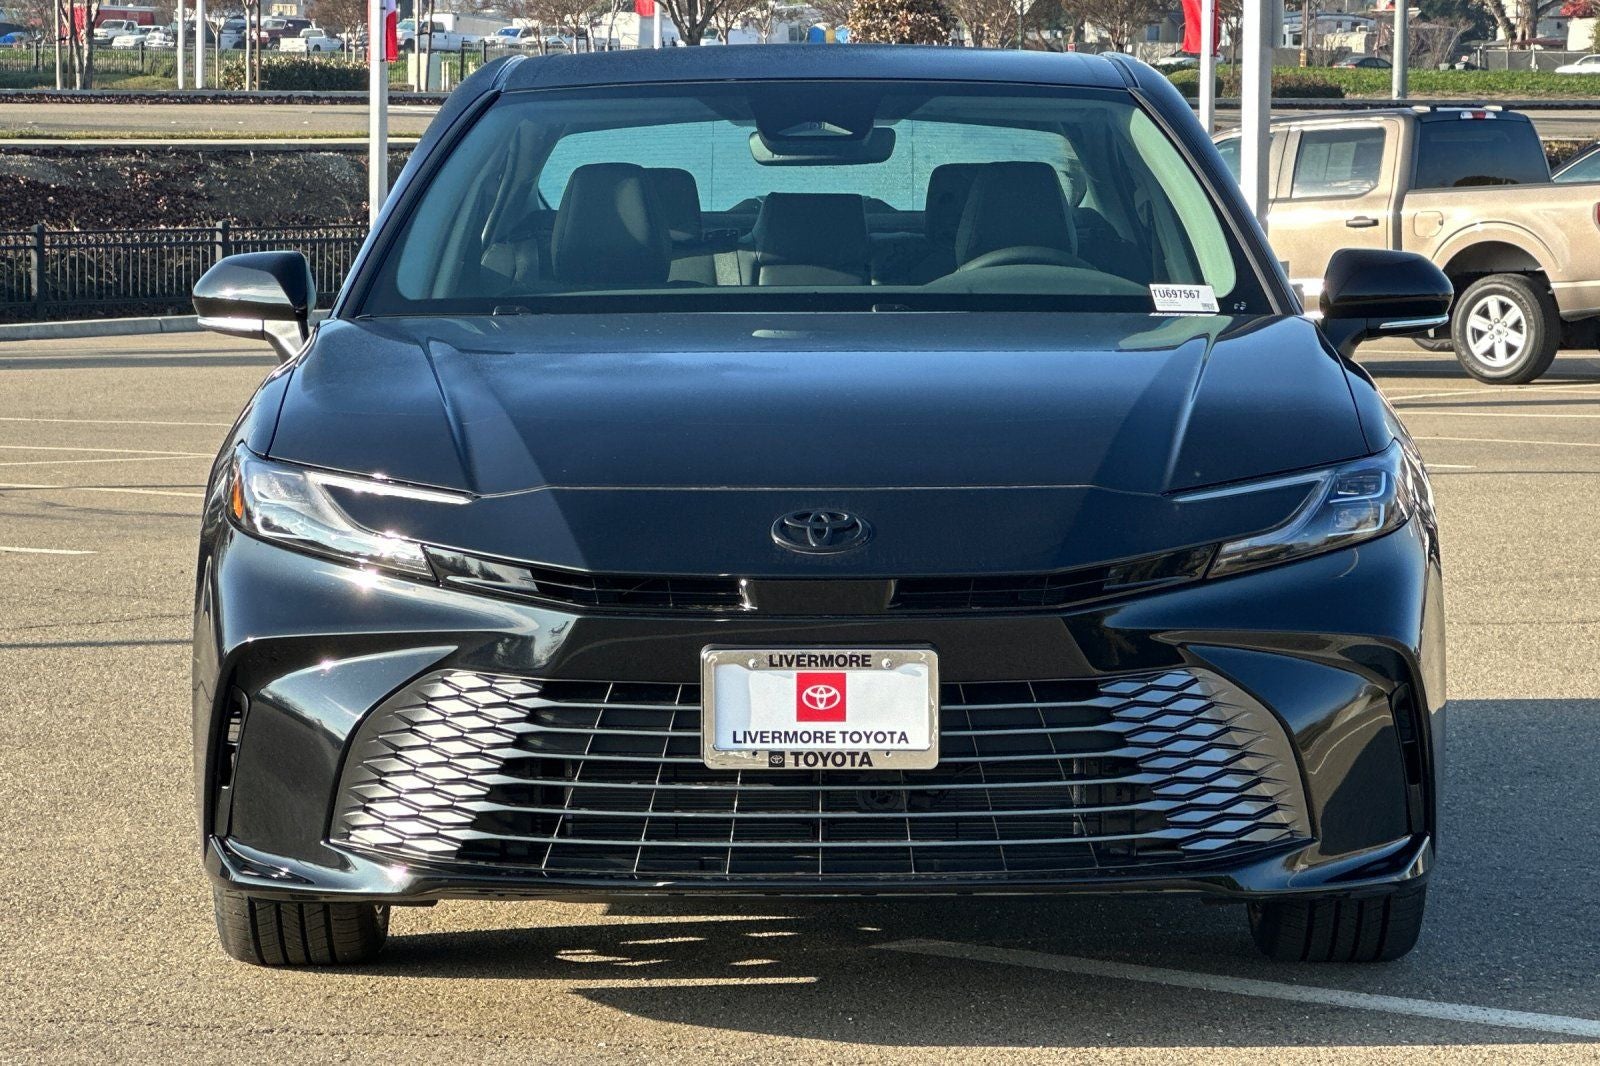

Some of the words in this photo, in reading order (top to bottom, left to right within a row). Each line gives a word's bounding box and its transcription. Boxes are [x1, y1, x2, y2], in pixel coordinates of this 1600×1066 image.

[1152, 289, 1200, 299] TU697567
[768, 654, 872, 668] LIVERMORE
[732, 731, 836, 744] LIVERMORE
[840, 731, 909, 744] TOYOTA
[790, 751, 874, 767] TOYOTA
